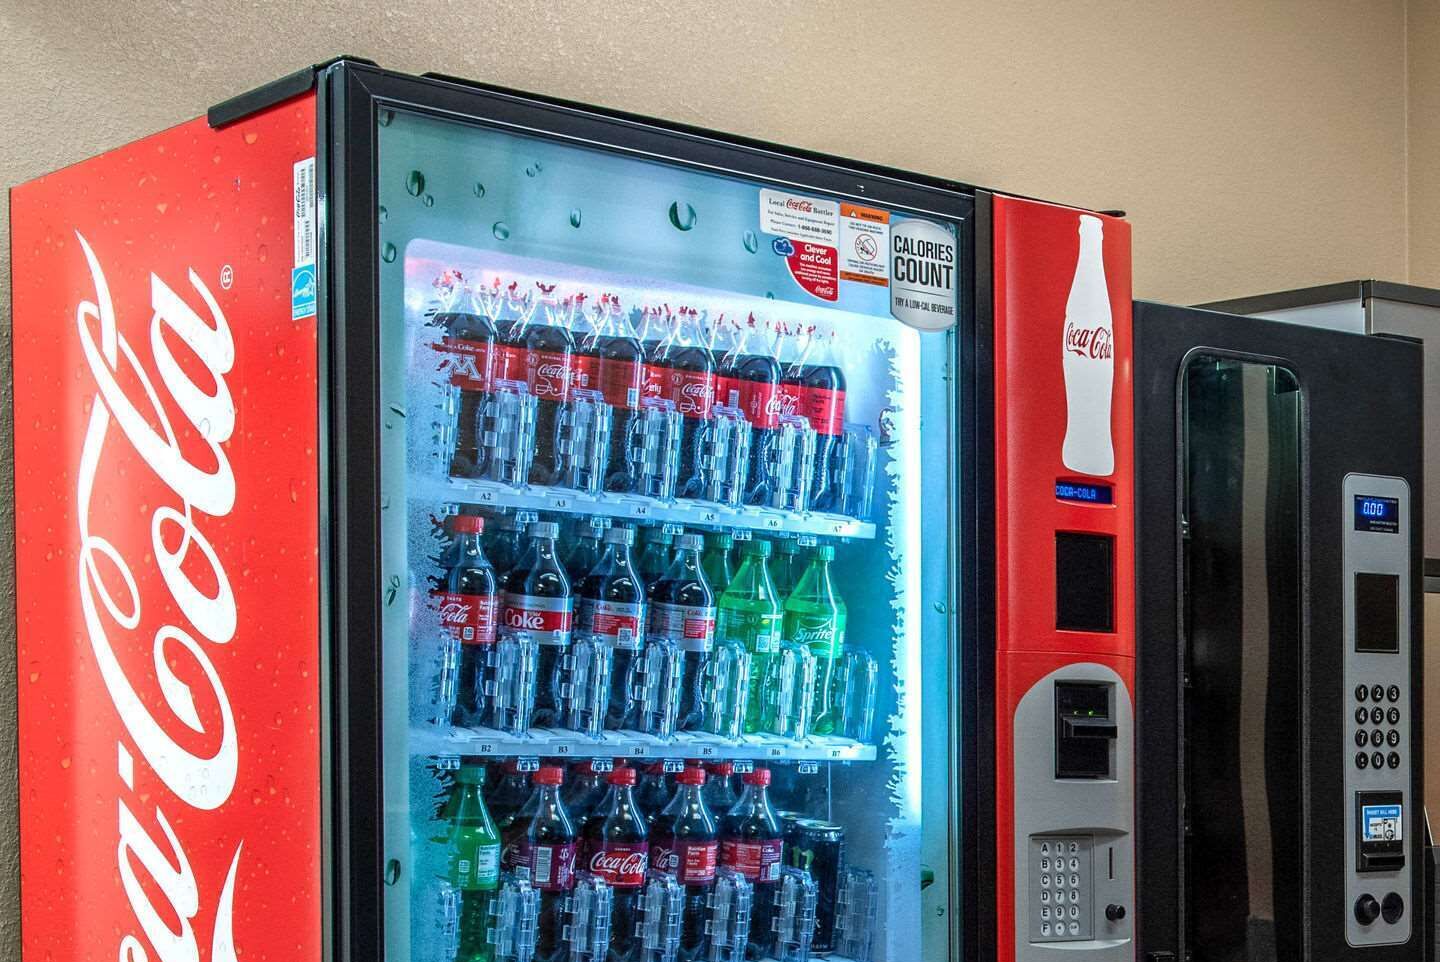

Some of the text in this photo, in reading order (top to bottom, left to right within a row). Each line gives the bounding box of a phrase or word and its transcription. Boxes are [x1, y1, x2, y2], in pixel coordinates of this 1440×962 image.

[768, 198, 785, 207] Local
[804, 243, 827, 255] Clever
[894, 235, 953, 263] CALORIES
[800, 254, 832, 265] and Cool
[894, 255, 953, 290] COUNT
[895, 297, 954, 316] TRY A LOW-CAL BEVERAGE
[1066, 322, 1111, 360] Coca-Cola
[480, 492, 491, 501] A2
[1055, 484, 1097, 500] COCA-COLA
[555, 499, 566, 508] A3
[1363, 502, 1383, 516] 0.00
[704, 513, 715, 521] A5
[767, 519, 778, 527] A6
[504, 608, 545, 630] Coke
[794, 627, 833, 642] Sprite
[1360, 687, 1397, 699] 1 2 3
[1360, 709, 1365, 720] 4
[1391, 710, 1397, 721] 6
[1360, 732, 1397, 744] 7 8 9
[481, 744, 492, 753] B2
[558, 745, 568, 753] B3
[634, 747, 644, 755] B4
[703, 747, 713, 755] B5
[1375, 755, 1381, 766] 0
[1041, 843, 1076, 852] A 1 2
[590, 851, 648, 875] Coca-Cola
[1041, 859, 1076, 869] B 3 4
[1041, 875, 1076, 885] C 5 6
[1042, 891, 1076, 901] D 7 8
[1042, 907, 1076, 917] E 9 0
[1042, 923, 1048, 933] F
